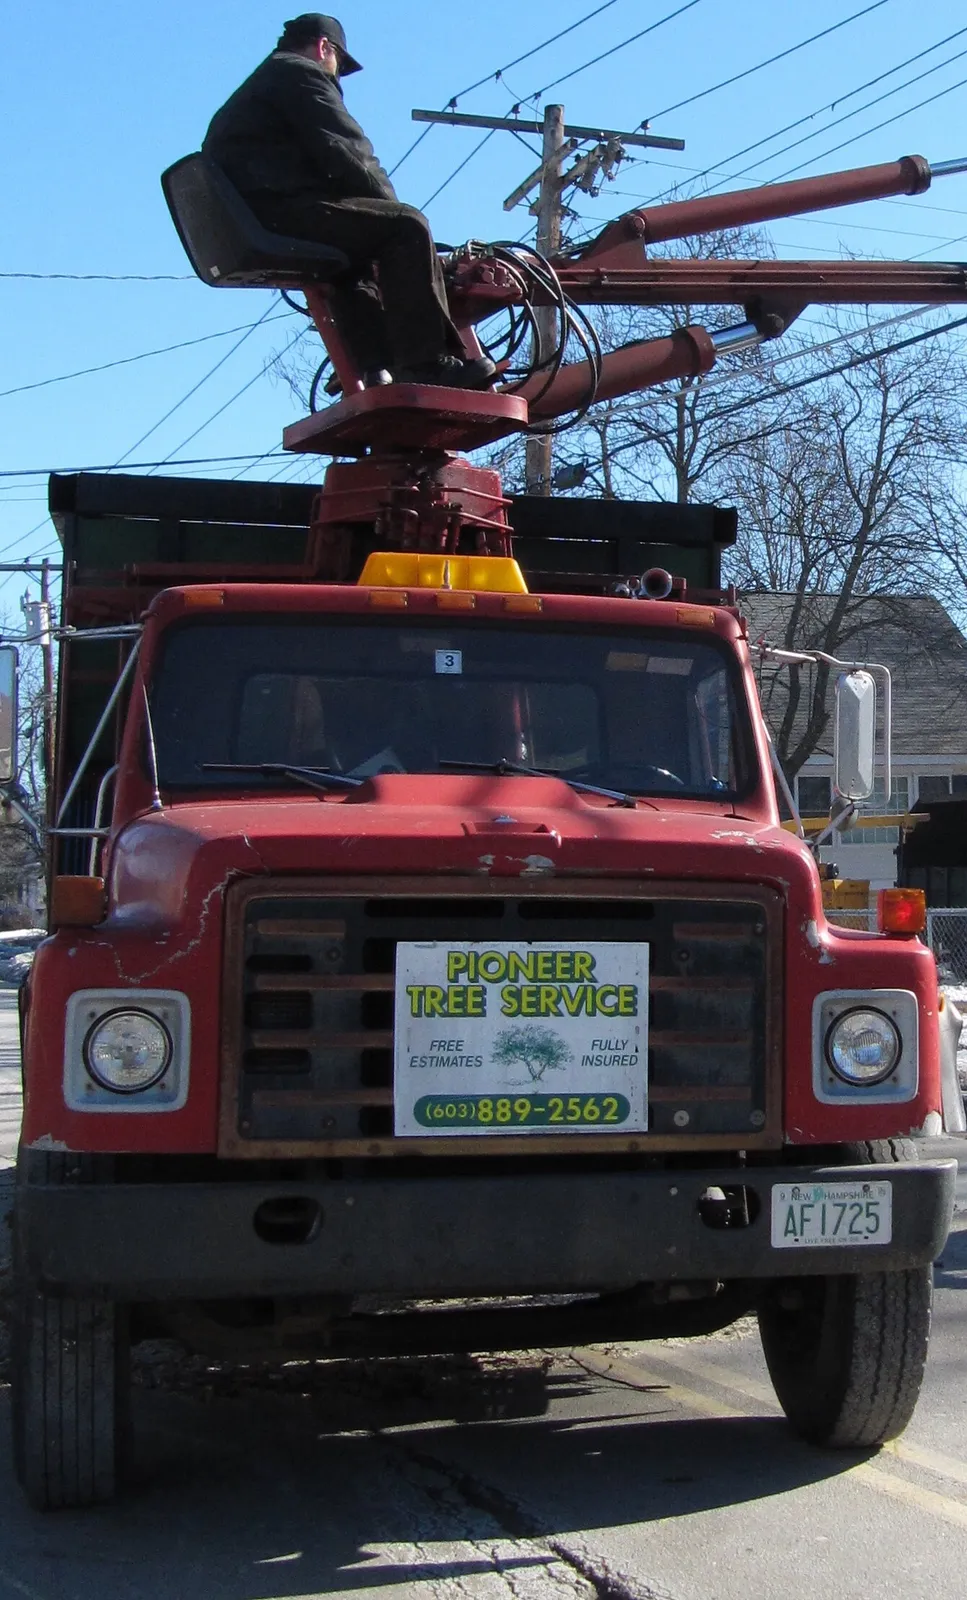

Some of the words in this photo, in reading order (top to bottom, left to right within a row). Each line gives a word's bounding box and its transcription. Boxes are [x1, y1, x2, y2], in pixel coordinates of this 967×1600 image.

[445, 655, 454, 667] 3
[447, 950, 597, 983] PIONEER
[406, 985, 487, 1018] TREE
[500, 984, 638, 1017] SERVICE
[429, 1040, 465, 1051] FREE
[591, 1039, 629, 1051] FULLY
[409, 1056, 483, 1068] ESTIMATES
[581, 1055, 638, 1067] INSURED
[791, 1191, 812, 1201] NEW
[824, 1190, 874, 1200] HAMPSHIRE
